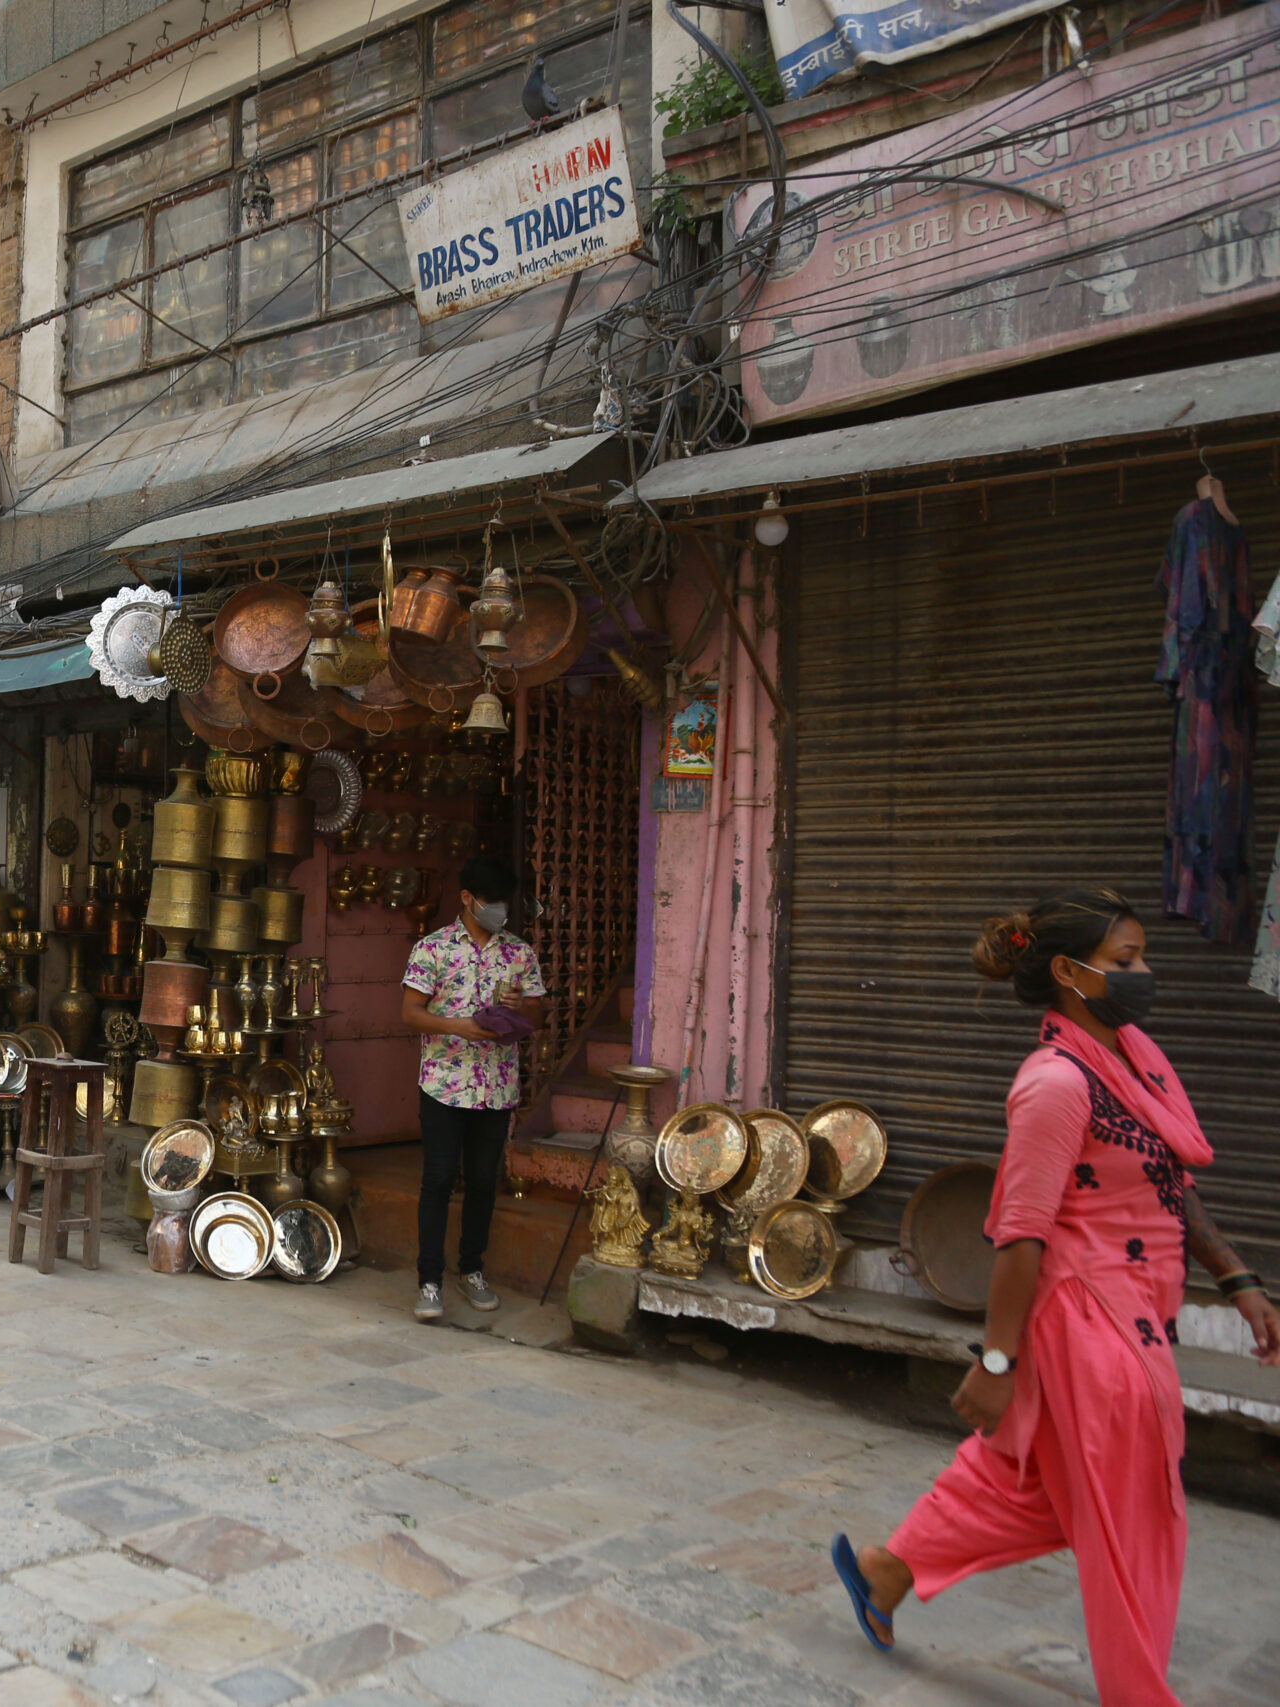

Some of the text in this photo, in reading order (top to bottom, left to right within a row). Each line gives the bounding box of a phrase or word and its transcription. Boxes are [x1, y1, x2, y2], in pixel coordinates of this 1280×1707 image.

[406, 193, 434, 225] SHREE
[417, 176, 625, 292] BRASS TRADERS
[833, 211, 954, 279] SHREE
[961, 159, 1136, 238] GANESH
